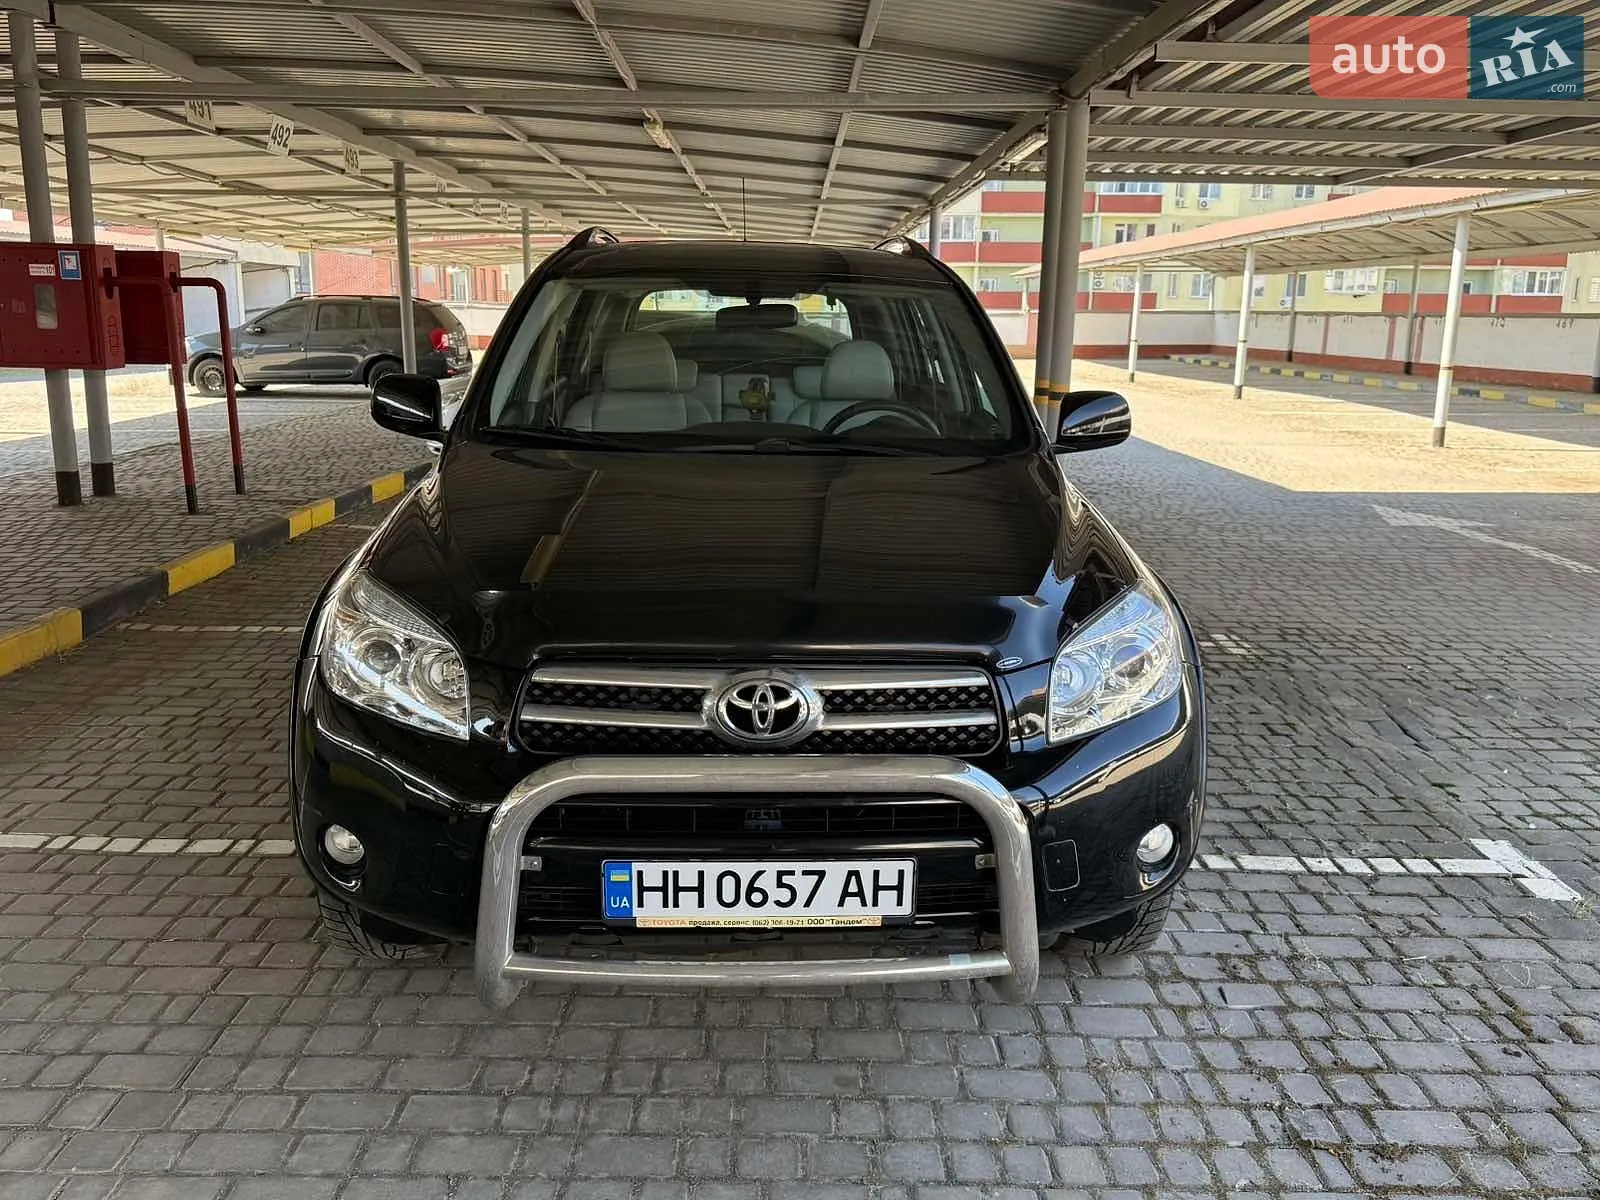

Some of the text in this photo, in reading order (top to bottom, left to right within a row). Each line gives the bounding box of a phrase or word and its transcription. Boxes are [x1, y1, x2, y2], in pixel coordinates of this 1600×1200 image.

[270, 123, 291, 148] 492
[344, 145, 359, 169] 493
[636, 869, 905, 909] HH 0657 AH
[610, 896, 630, 908] UA
